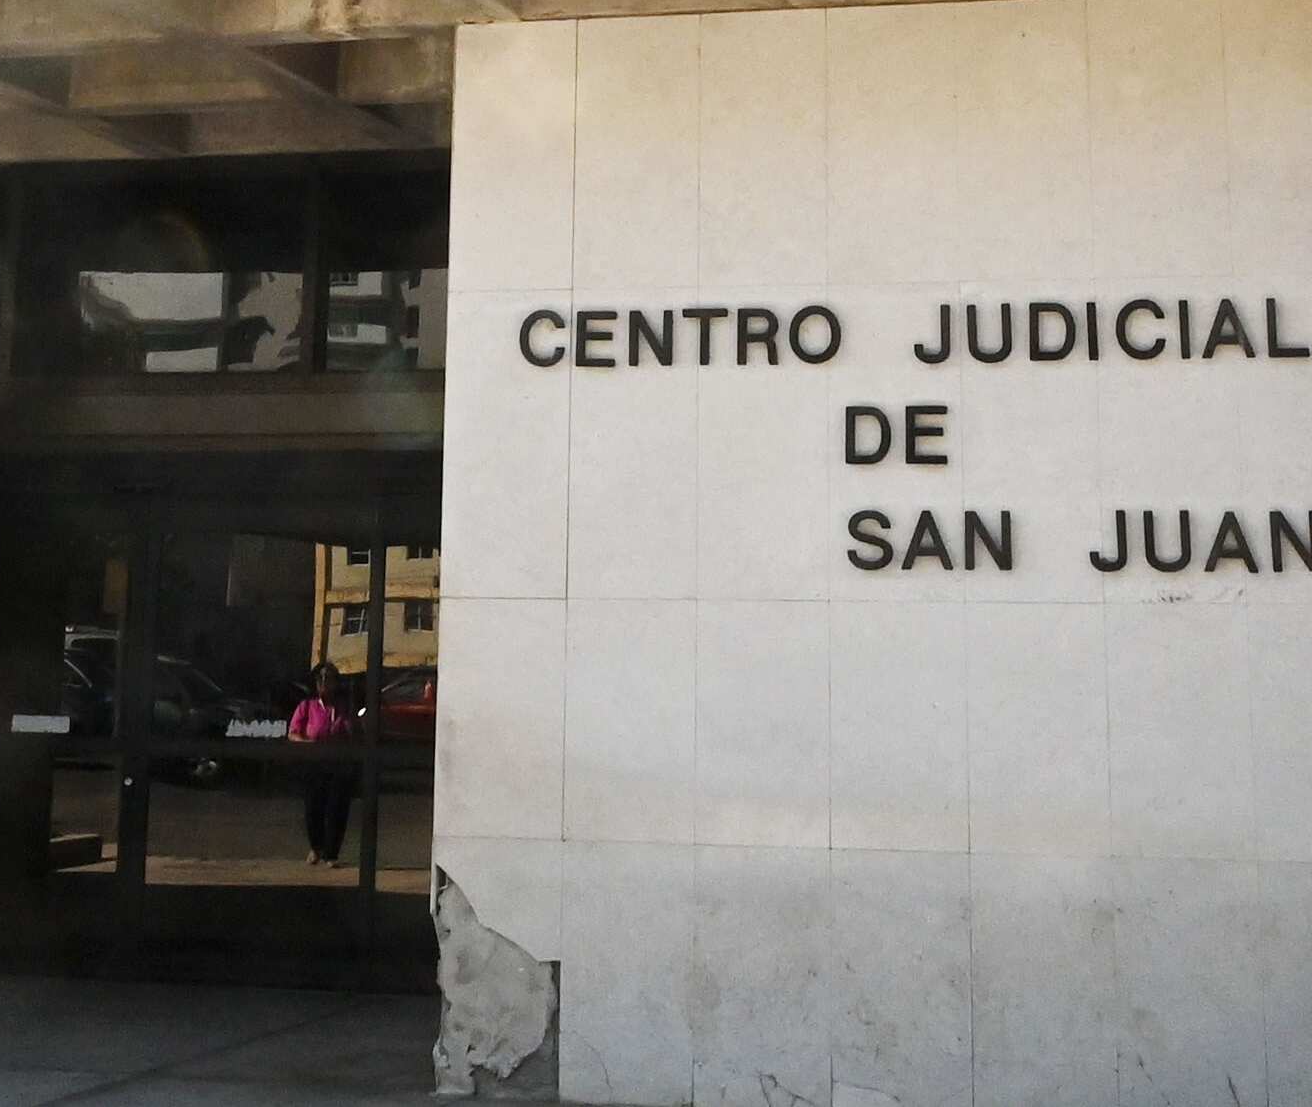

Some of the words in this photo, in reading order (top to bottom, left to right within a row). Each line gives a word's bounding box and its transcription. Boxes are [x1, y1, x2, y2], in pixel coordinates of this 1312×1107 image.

[520, 306, 842, 368] CENTRO
[914, 298, 1311, 365] JUDICIAL
[845, 404, 949, 465] DE
[847, 510, 1013, 571] SAN
